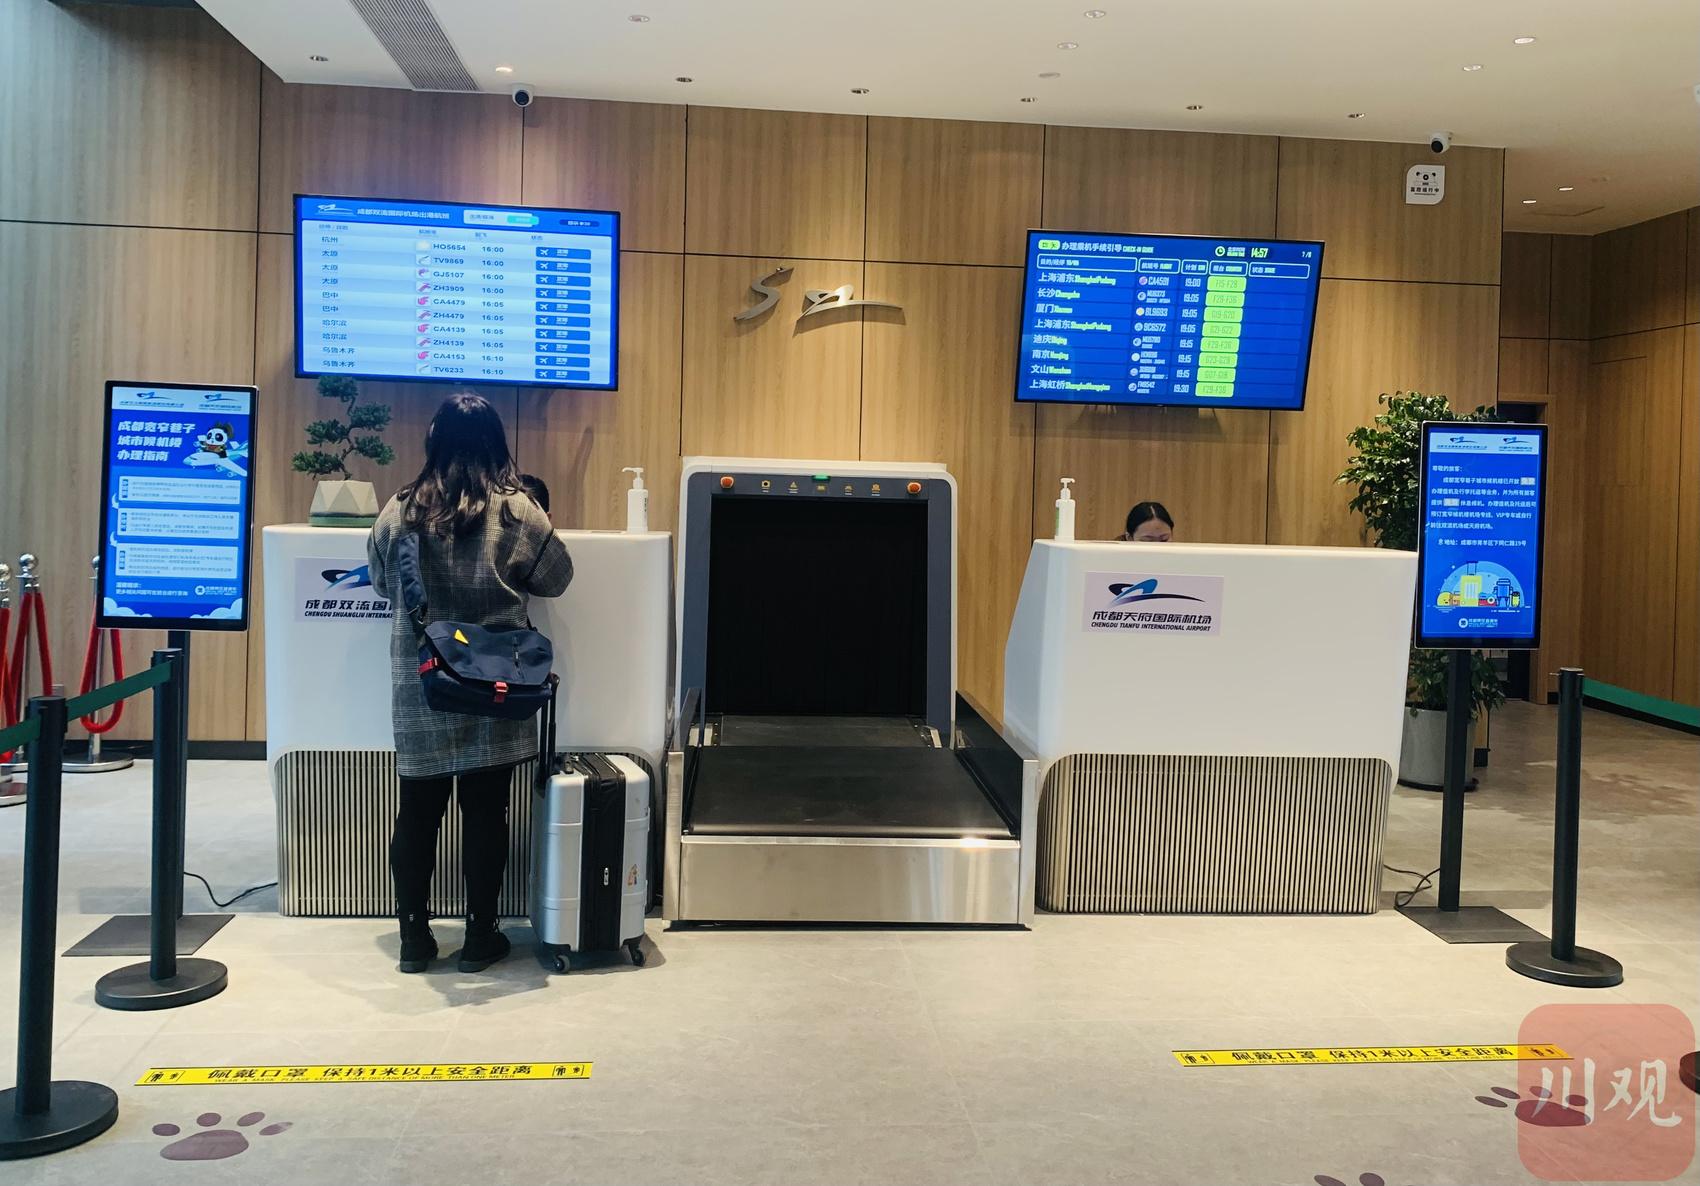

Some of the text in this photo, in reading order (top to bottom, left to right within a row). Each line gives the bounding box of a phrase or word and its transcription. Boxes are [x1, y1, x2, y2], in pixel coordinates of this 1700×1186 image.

[1251, 247, 1268, 258] 14:57
[482, 273, 504, 281] 16:00
[1038, 272, 1075, 283] 上海浦东
[482, 287, 504, 295] 16:00
[1037, 287, 1055, 298] 长沙
[482, 314, 504, 322] 16:05
[1034, 318, 1071, 329] 上海浦东
[482, 341, 504, 349] 16:05
[1032, 349, 1050, 359] 南京
[482, 368, 504, 376] 16:10
[1031, 364, 1048, 374] 文山
[1029, 379, 1065, 390] 上海虹桥
[117, 450, 169, 462] 办理指南
[305, 600, 392, 611] 成都双流国
[1093, 611, 1212, 625] 成都天府国际机场
[1141, 623, 1184, 631] INTERNATIONAL
[1232, 1050, 1318, 1060] 佩戴口罩
[1329, 1047, 1514, 1059] 保持1米以上安全距离
[208, 1065, 532, 1079] 佩戴口罩 保持1米以上安全距离
